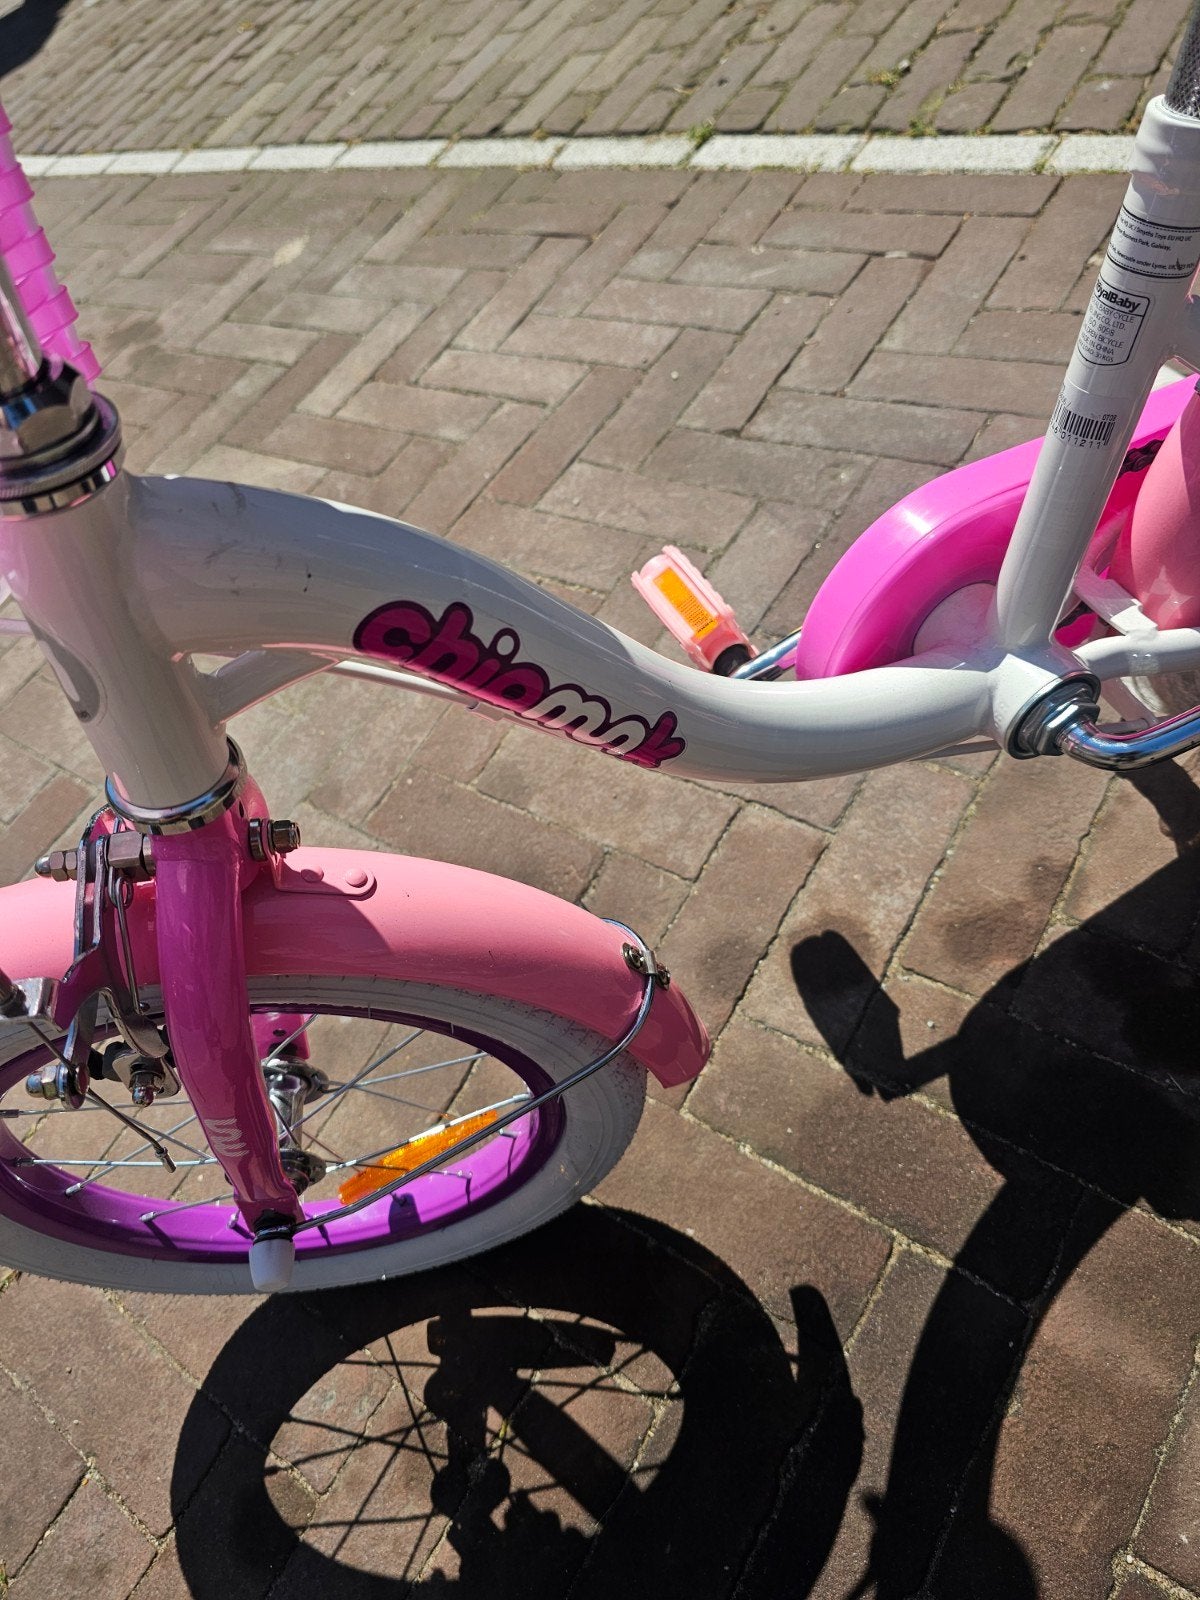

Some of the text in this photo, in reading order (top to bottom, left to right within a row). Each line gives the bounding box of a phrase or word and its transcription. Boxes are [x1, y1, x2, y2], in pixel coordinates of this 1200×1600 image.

[1113, 312, 1135, 324] CYCLE
[1097, 333, 1125, 349] BICYCLE
[1095, 343, 1114, 355] CHINA
